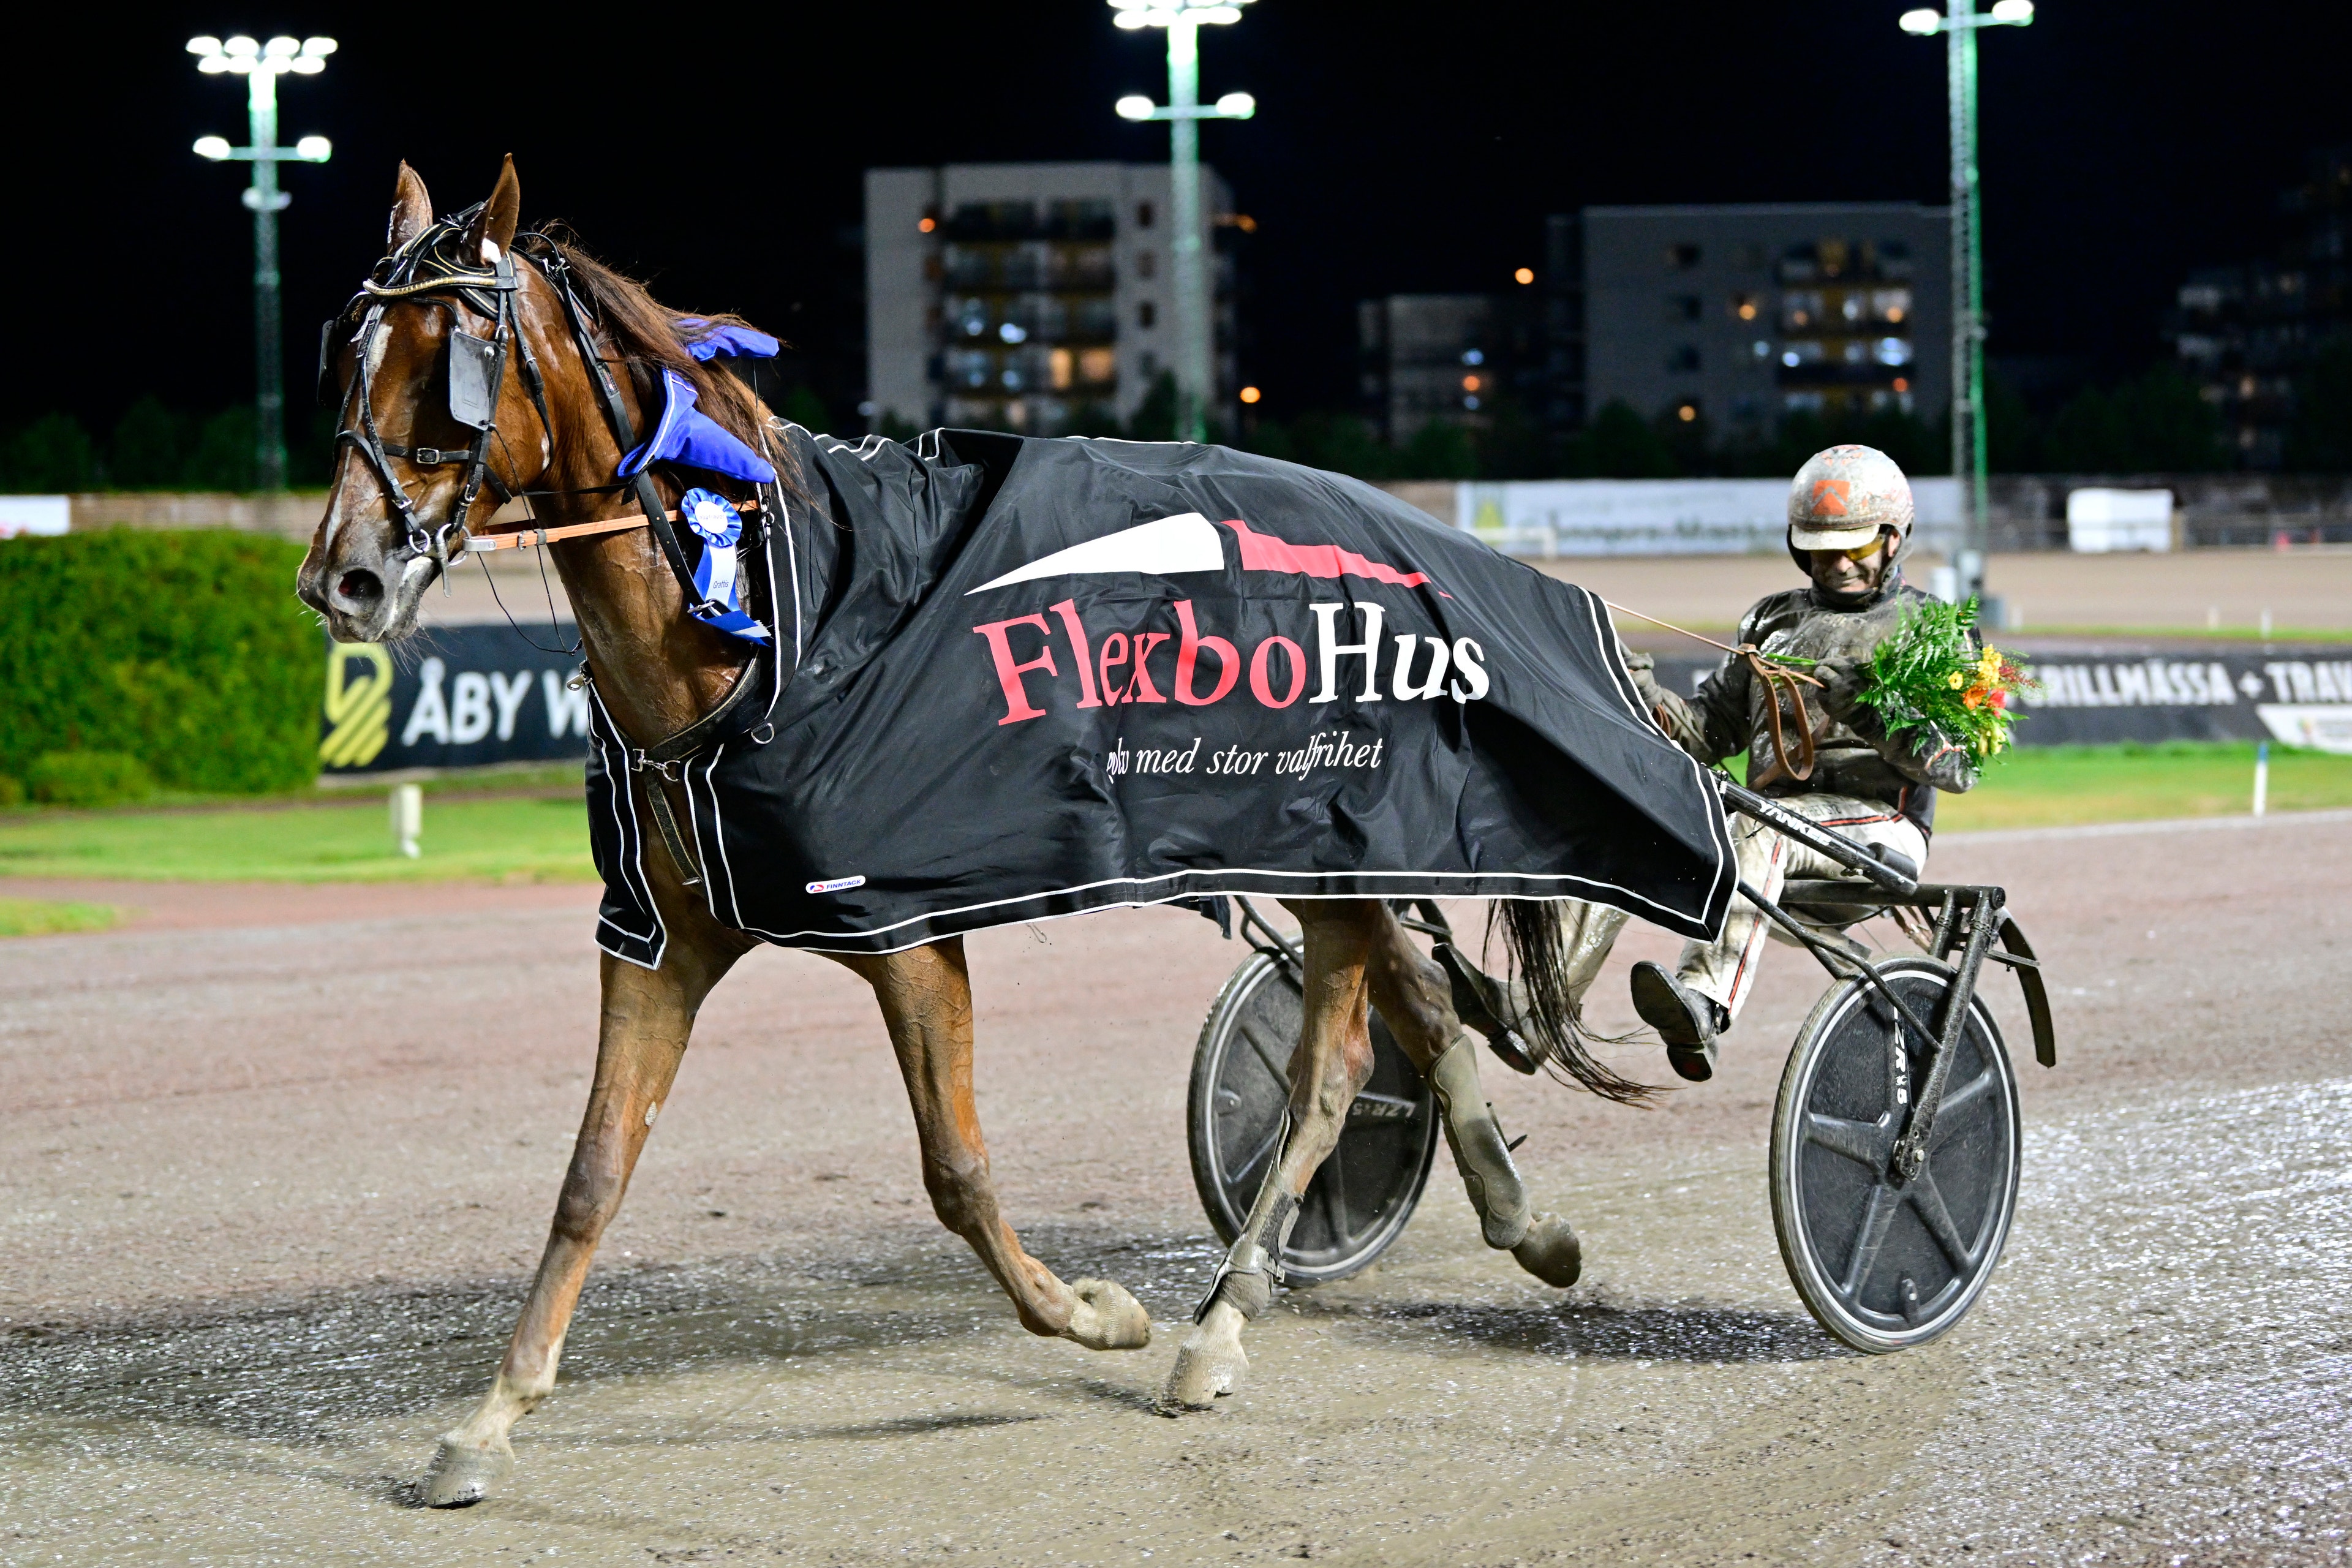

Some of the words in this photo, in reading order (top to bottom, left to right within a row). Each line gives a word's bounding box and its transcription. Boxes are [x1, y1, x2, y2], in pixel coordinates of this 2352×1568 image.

[973, 599, 1490, 726] FlexboHus
[402, 657, 532, 746] ÅBY
[1136, 737, 1201, 774] med
[1206, 744, 1268, 775] stor
[1275, 731, 1383, 781] valfrihet
[1756, 800, 1831, 846] YANKEE
[827, 880, 861, 889] FINNTACK
